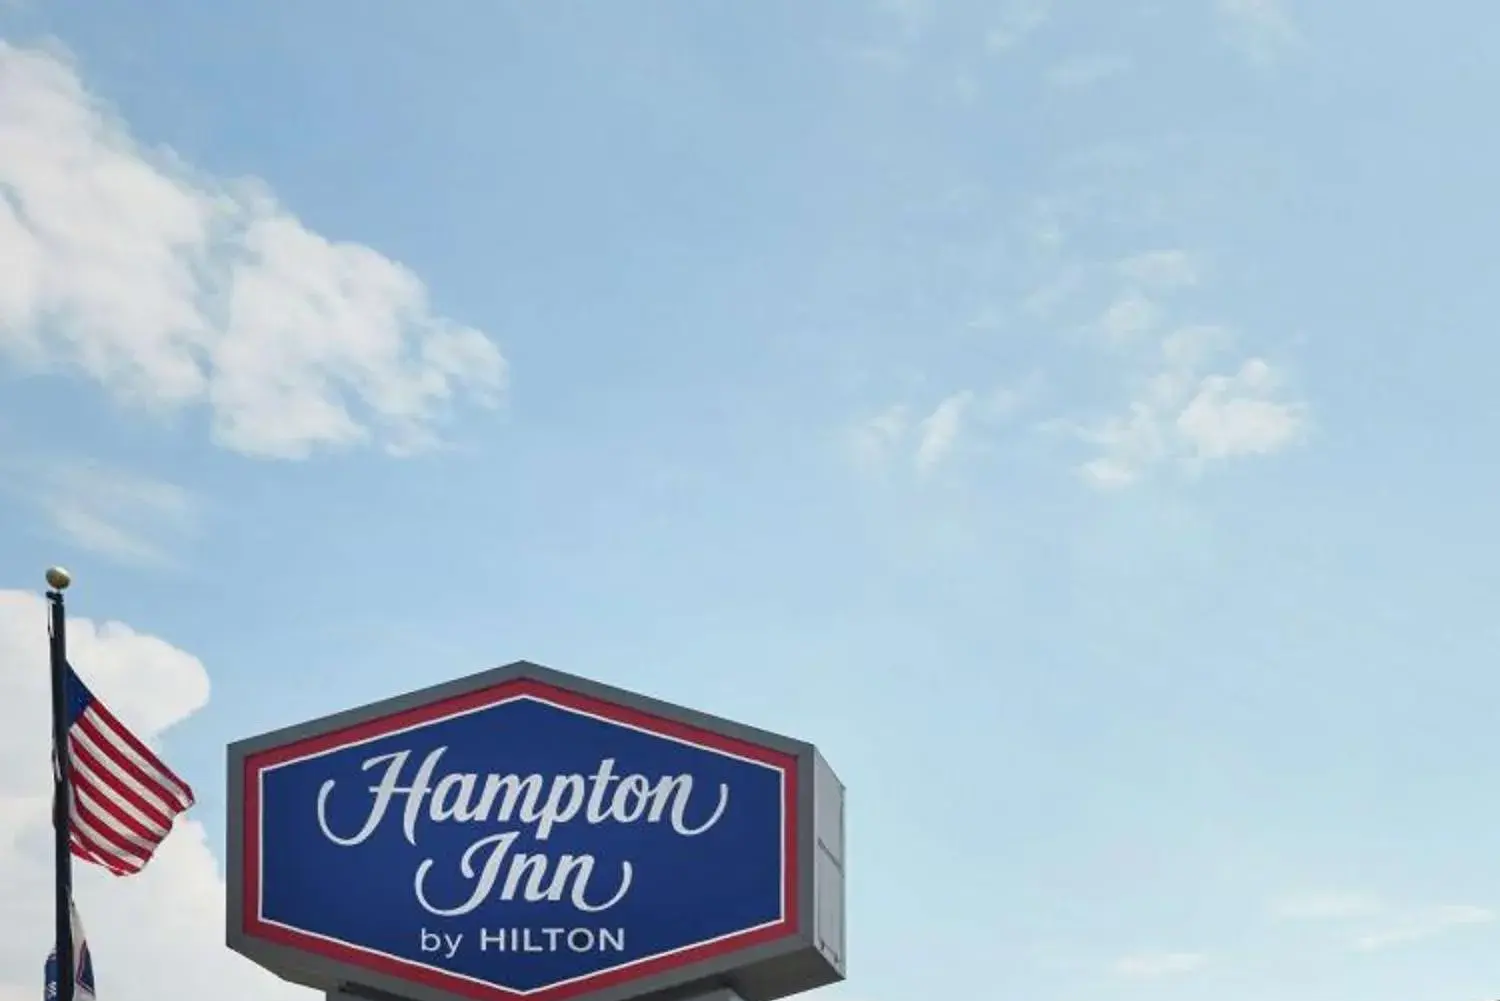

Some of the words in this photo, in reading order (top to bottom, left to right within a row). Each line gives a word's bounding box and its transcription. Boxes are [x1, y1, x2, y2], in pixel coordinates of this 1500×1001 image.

[317, 745, 728, 846] Hampton
[414, 831, 632, 916] Inn
[420, 927, 463, 958] by
[481, 927, 625, 952] HILTON
